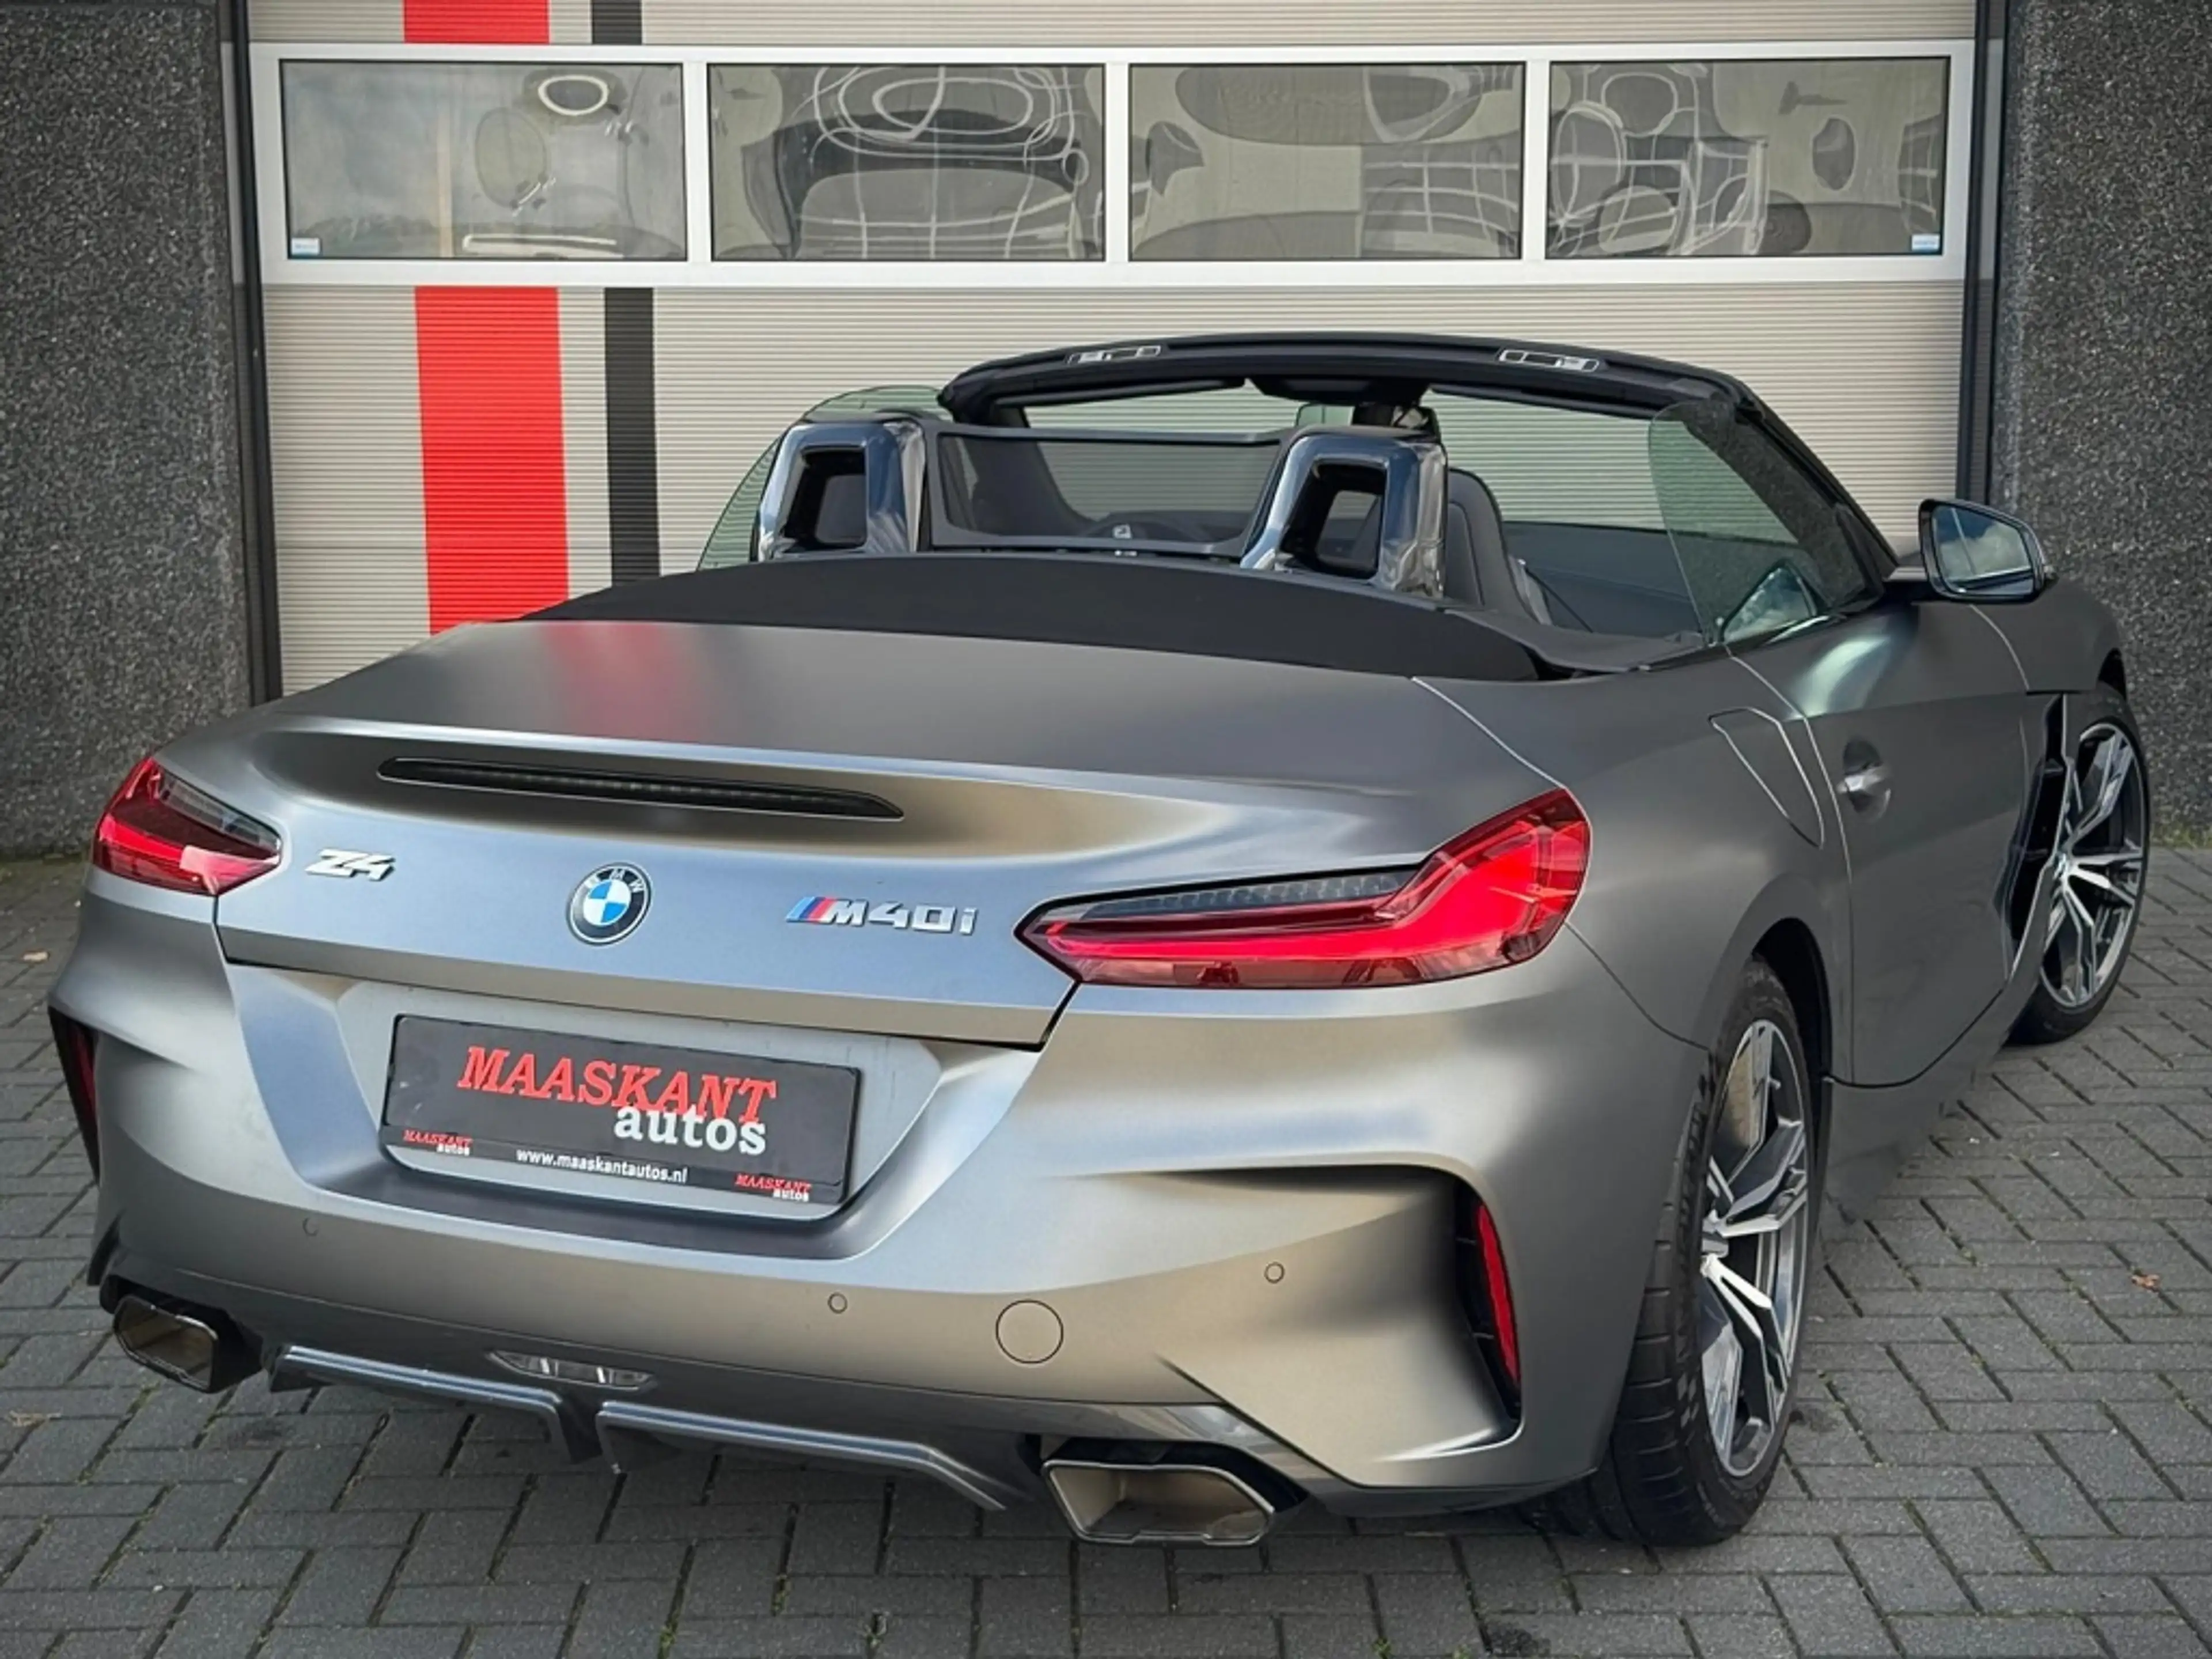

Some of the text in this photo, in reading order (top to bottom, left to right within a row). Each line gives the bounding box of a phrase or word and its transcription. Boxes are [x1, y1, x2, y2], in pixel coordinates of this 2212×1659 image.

[304, 848, 396, 882] Z4
[818, 897, 978, 935] M40i
[457, 1046, 777, 1124] MAASKANT
[403, 1128, 474, 1148] MAASKANT
[614, 1104, 766, 1156] autos
[516, 1149, 688, 1183] www.maaskantautos.nl
[734, 1173, 812, 1192] MAASKANT
[772, 1188, 809, 1202] autos
